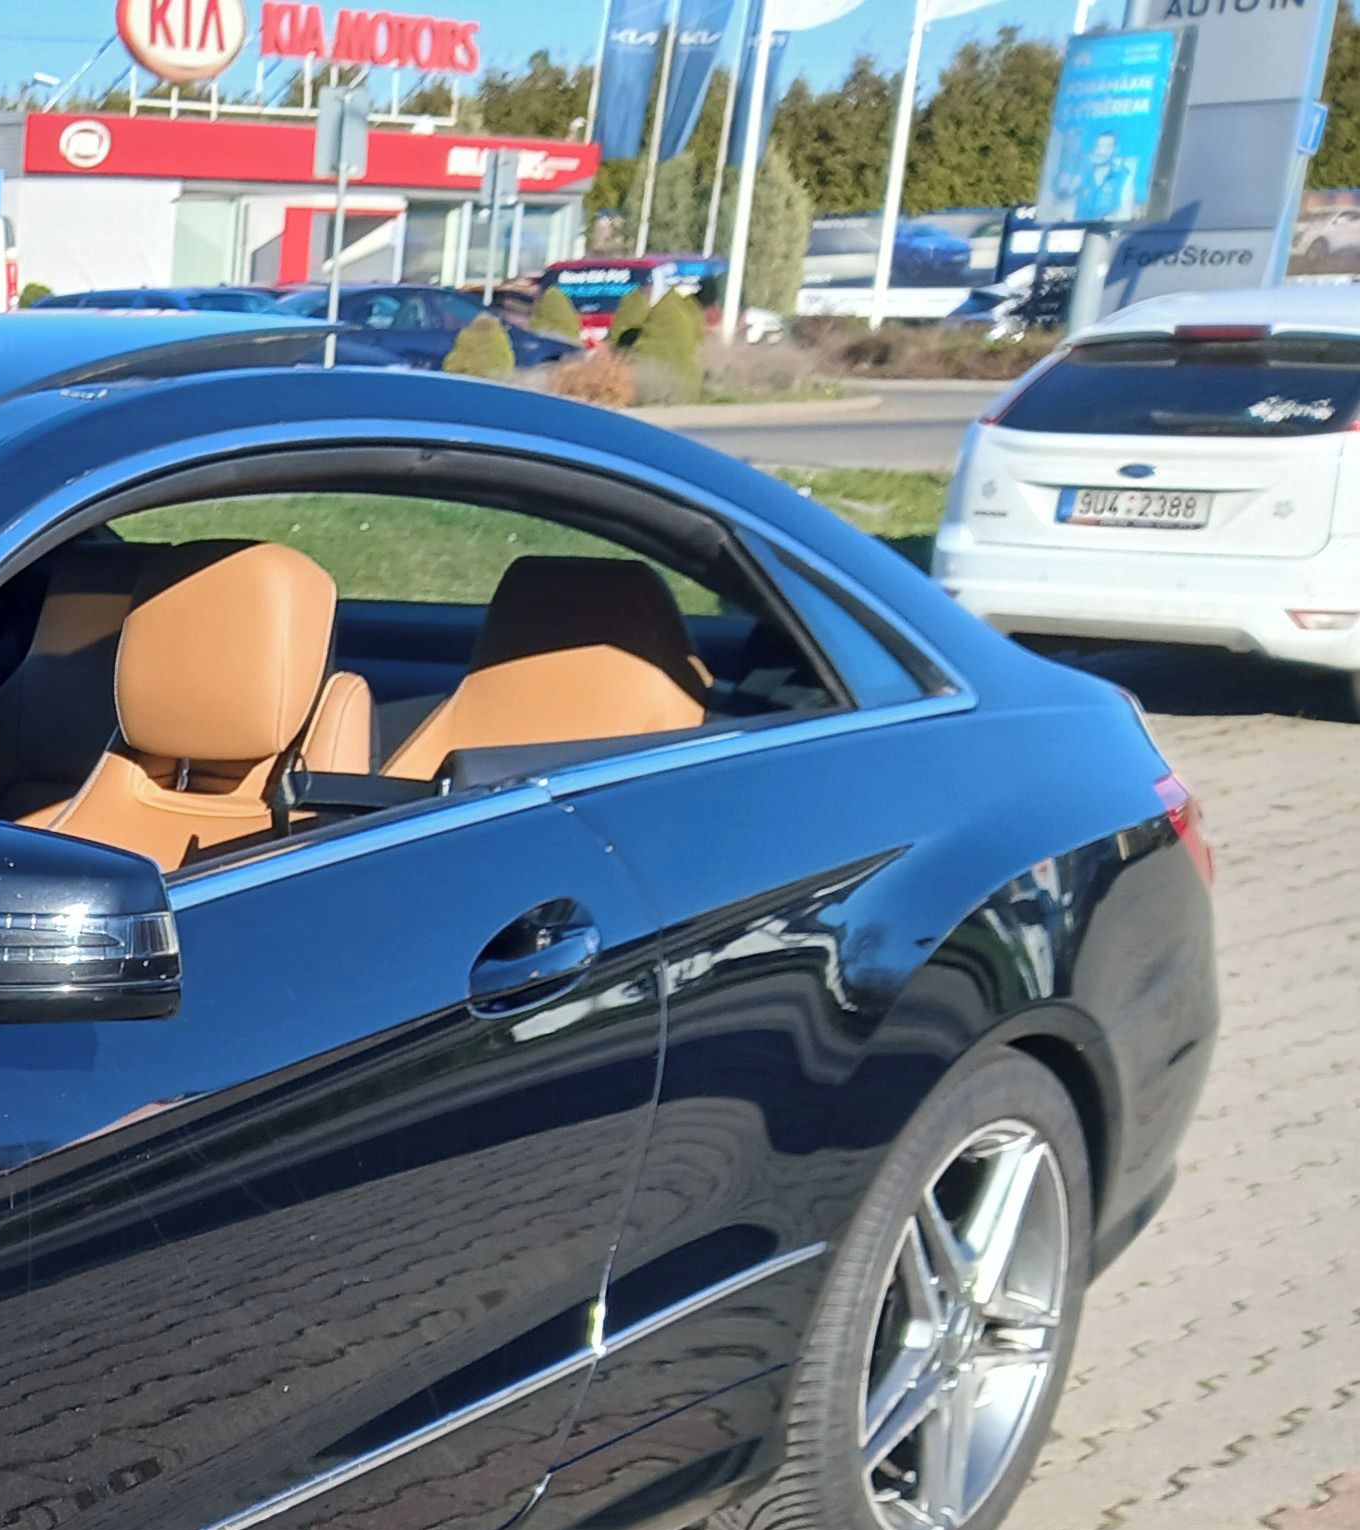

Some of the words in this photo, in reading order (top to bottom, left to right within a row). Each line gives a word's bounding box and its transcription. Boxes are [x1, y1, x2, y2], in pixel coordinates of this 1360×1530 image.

[149, 0, 225, 52] KIA
[260, 2, 325, 58] KIA
[332, 9, 480, 73] MOTORS
[1122, 244, 1254, 268] FordStore
[1078, 492, 1119, 515] 9U4
[1137, 495, 1197, 519] 2388
